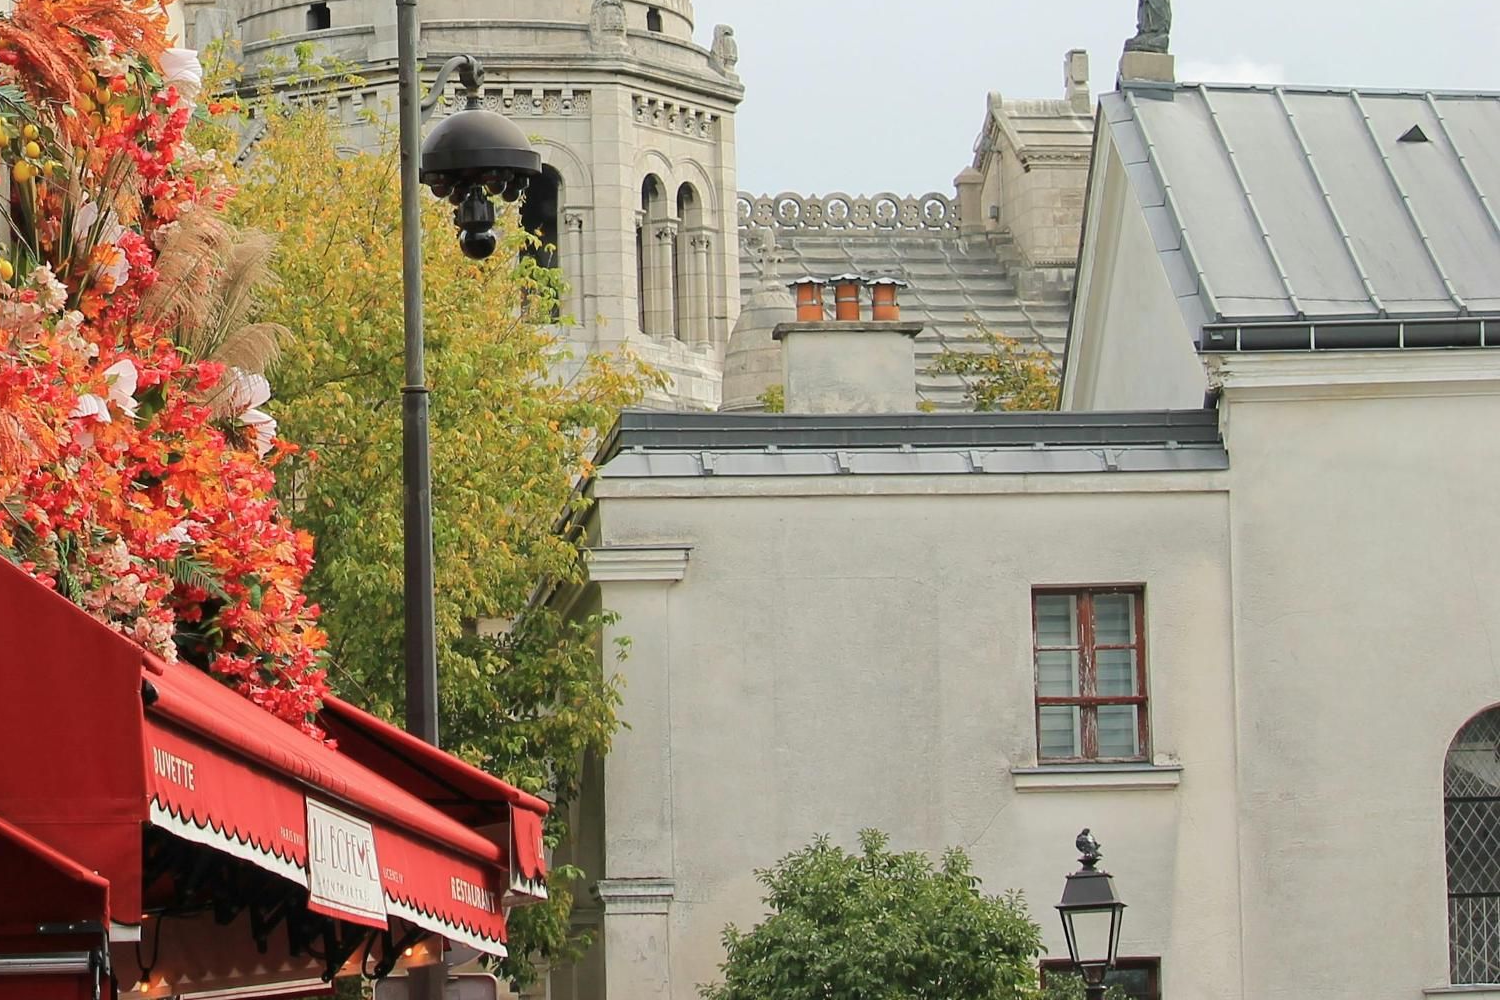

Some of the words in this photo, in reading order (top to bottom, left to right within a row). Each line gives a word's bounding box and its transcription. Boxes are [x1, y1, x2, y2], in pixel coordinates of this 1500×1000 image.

[153, 746, 195, 791] BUVETTE
[313, 818, 326, 864] LA
[451, 876, 496, 914] RESTAURANT
